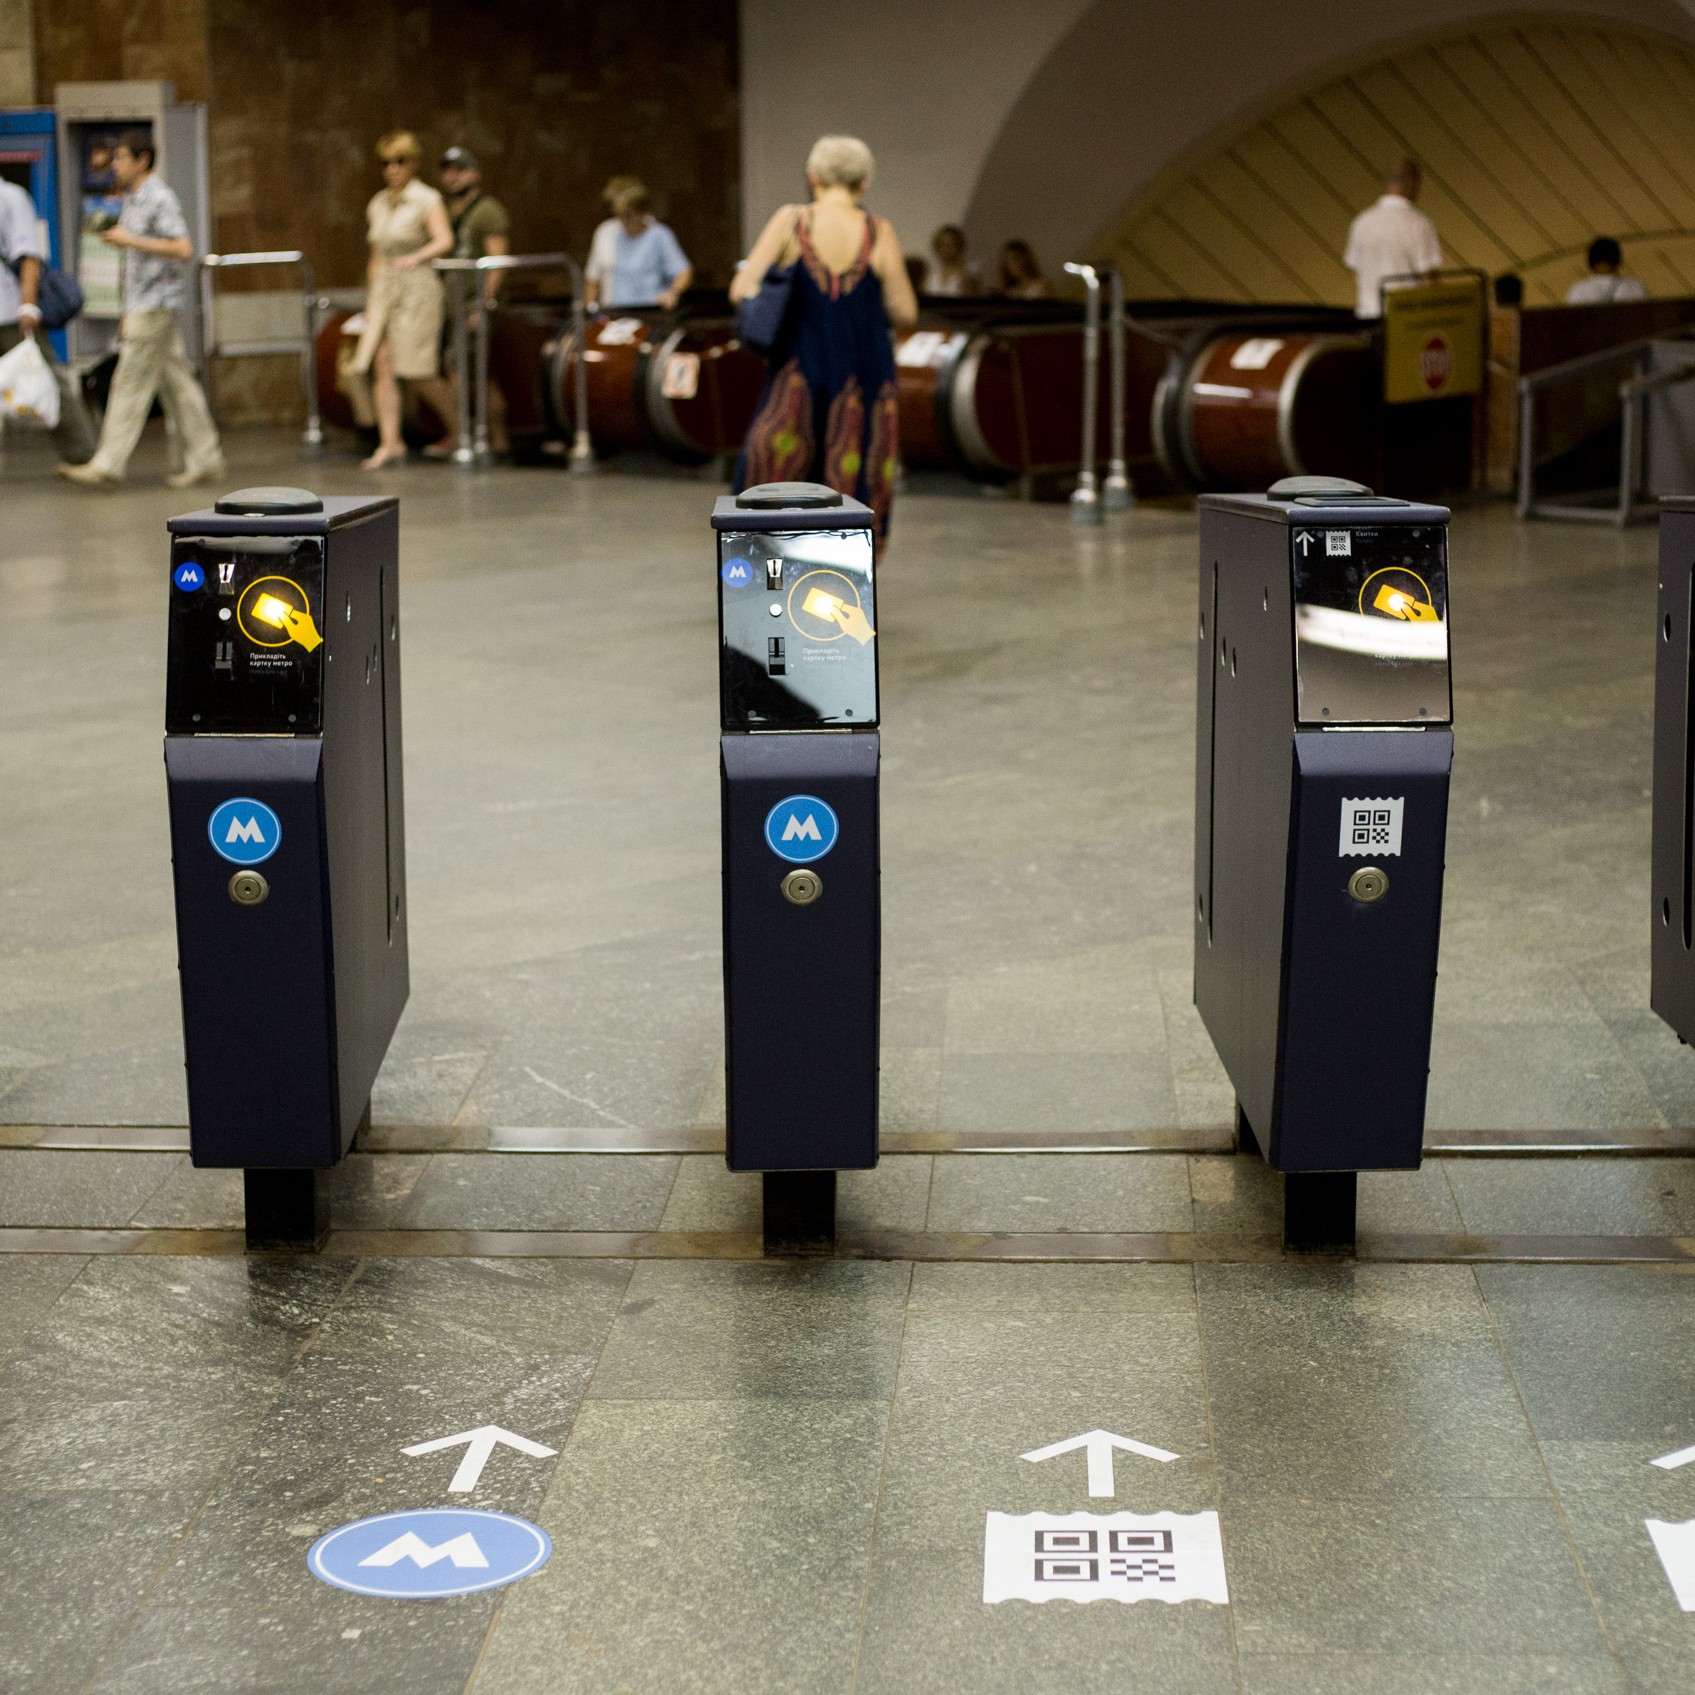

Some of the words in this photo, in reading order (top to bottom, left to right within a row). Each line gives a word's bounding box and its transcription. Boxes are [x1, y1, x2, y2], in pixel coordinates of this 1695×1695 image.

[249, 652, 287, 660] Прикладіть
[249, 660, 271, 669] картку
[272, 660, 293, 668] метро
